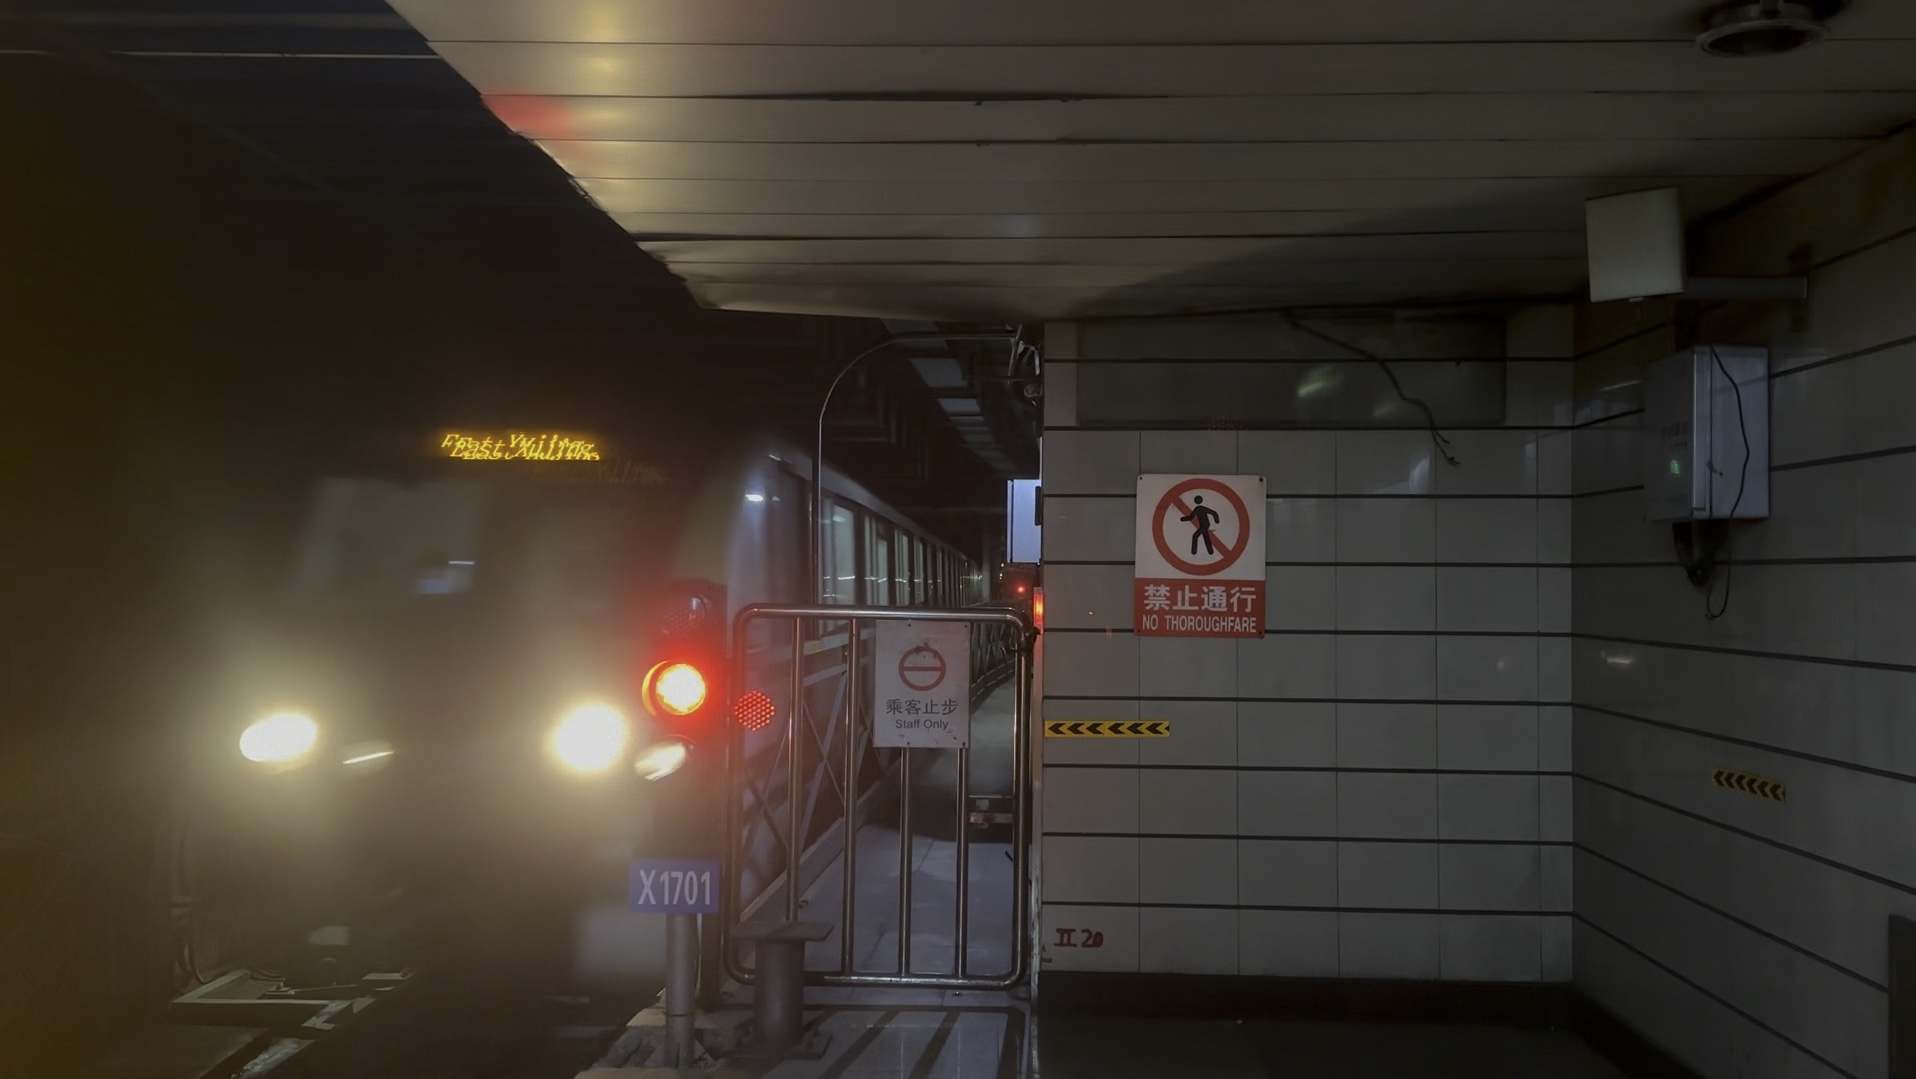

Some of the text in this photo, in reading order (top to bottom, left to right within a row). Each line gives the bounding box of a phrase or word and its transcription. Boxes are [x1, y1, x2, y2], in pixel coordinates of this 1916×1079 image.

[441, 433, 505, 461] East
[1144, 584, 1256, 613] 禁止通行
[1142, 614, 1257, 633] NO THOROUGHFARE
[885, 698, 958, 716] 乘客止步
[895, 719, 949, 731] Staff Only
[638, 869, 711, 905] X1701
